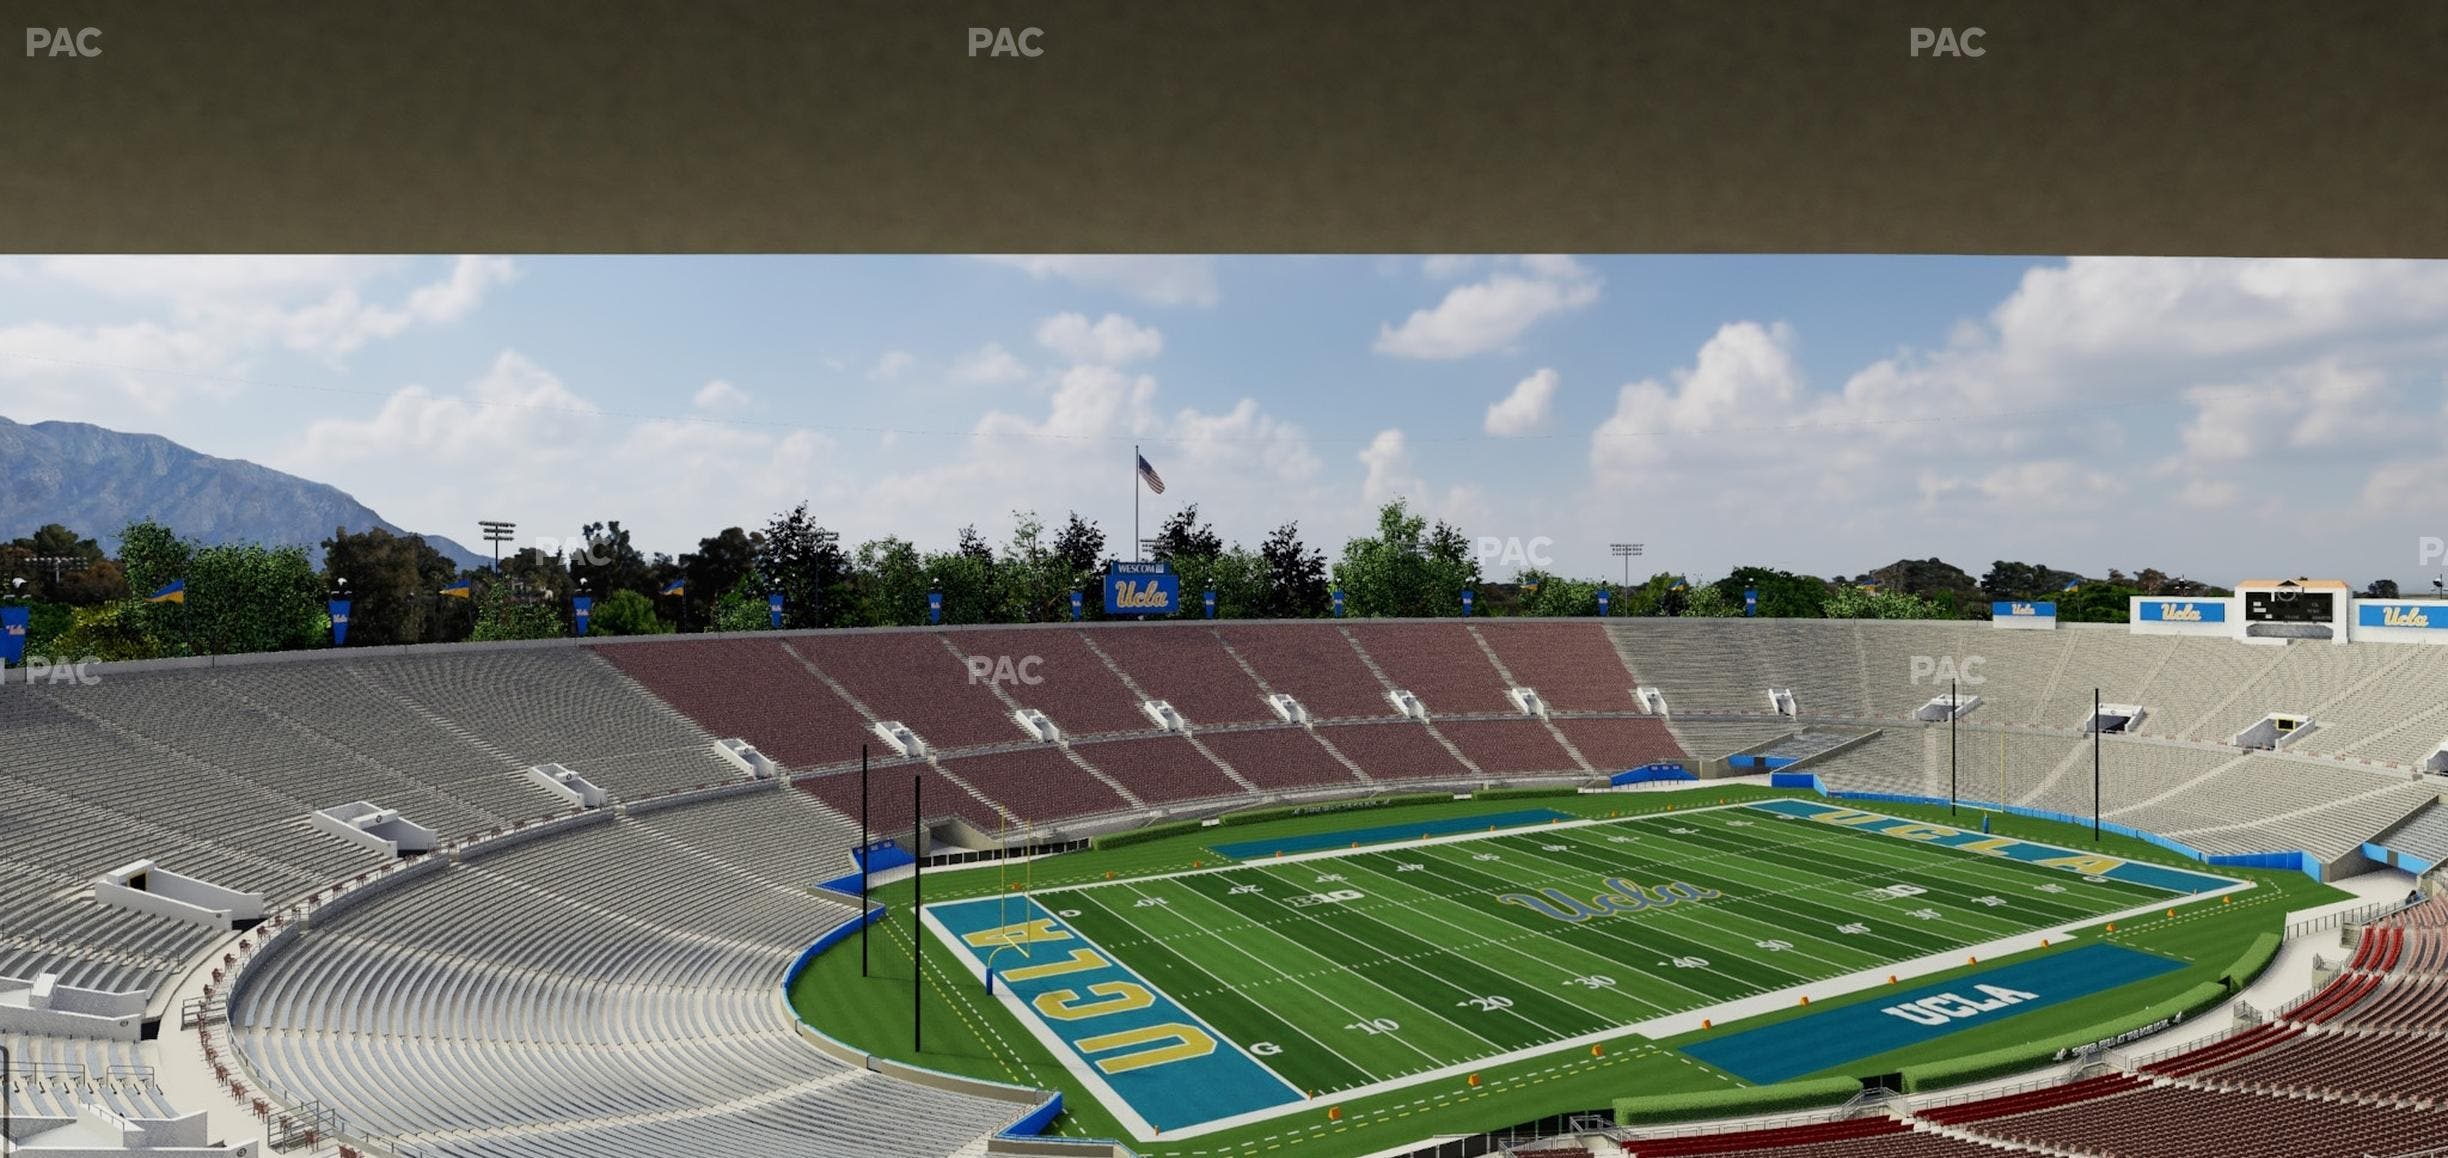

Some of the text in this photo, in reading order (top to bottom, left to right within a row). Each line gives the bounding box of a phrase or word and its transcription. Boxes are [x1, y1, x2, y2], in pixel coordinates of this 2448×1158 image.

[1118, 564, 1154, 574] WESCOM
[1496, 877, 1722, 922] Ucla
[1575, 975, 1616, 989] 30
[1469, 995, 1514, 1012] 20
[1880, 984, 2040, 1025] UCLA
[1355, 1018, 1399, 1035] 10
[1250, 1041, 1283, 1056] G
